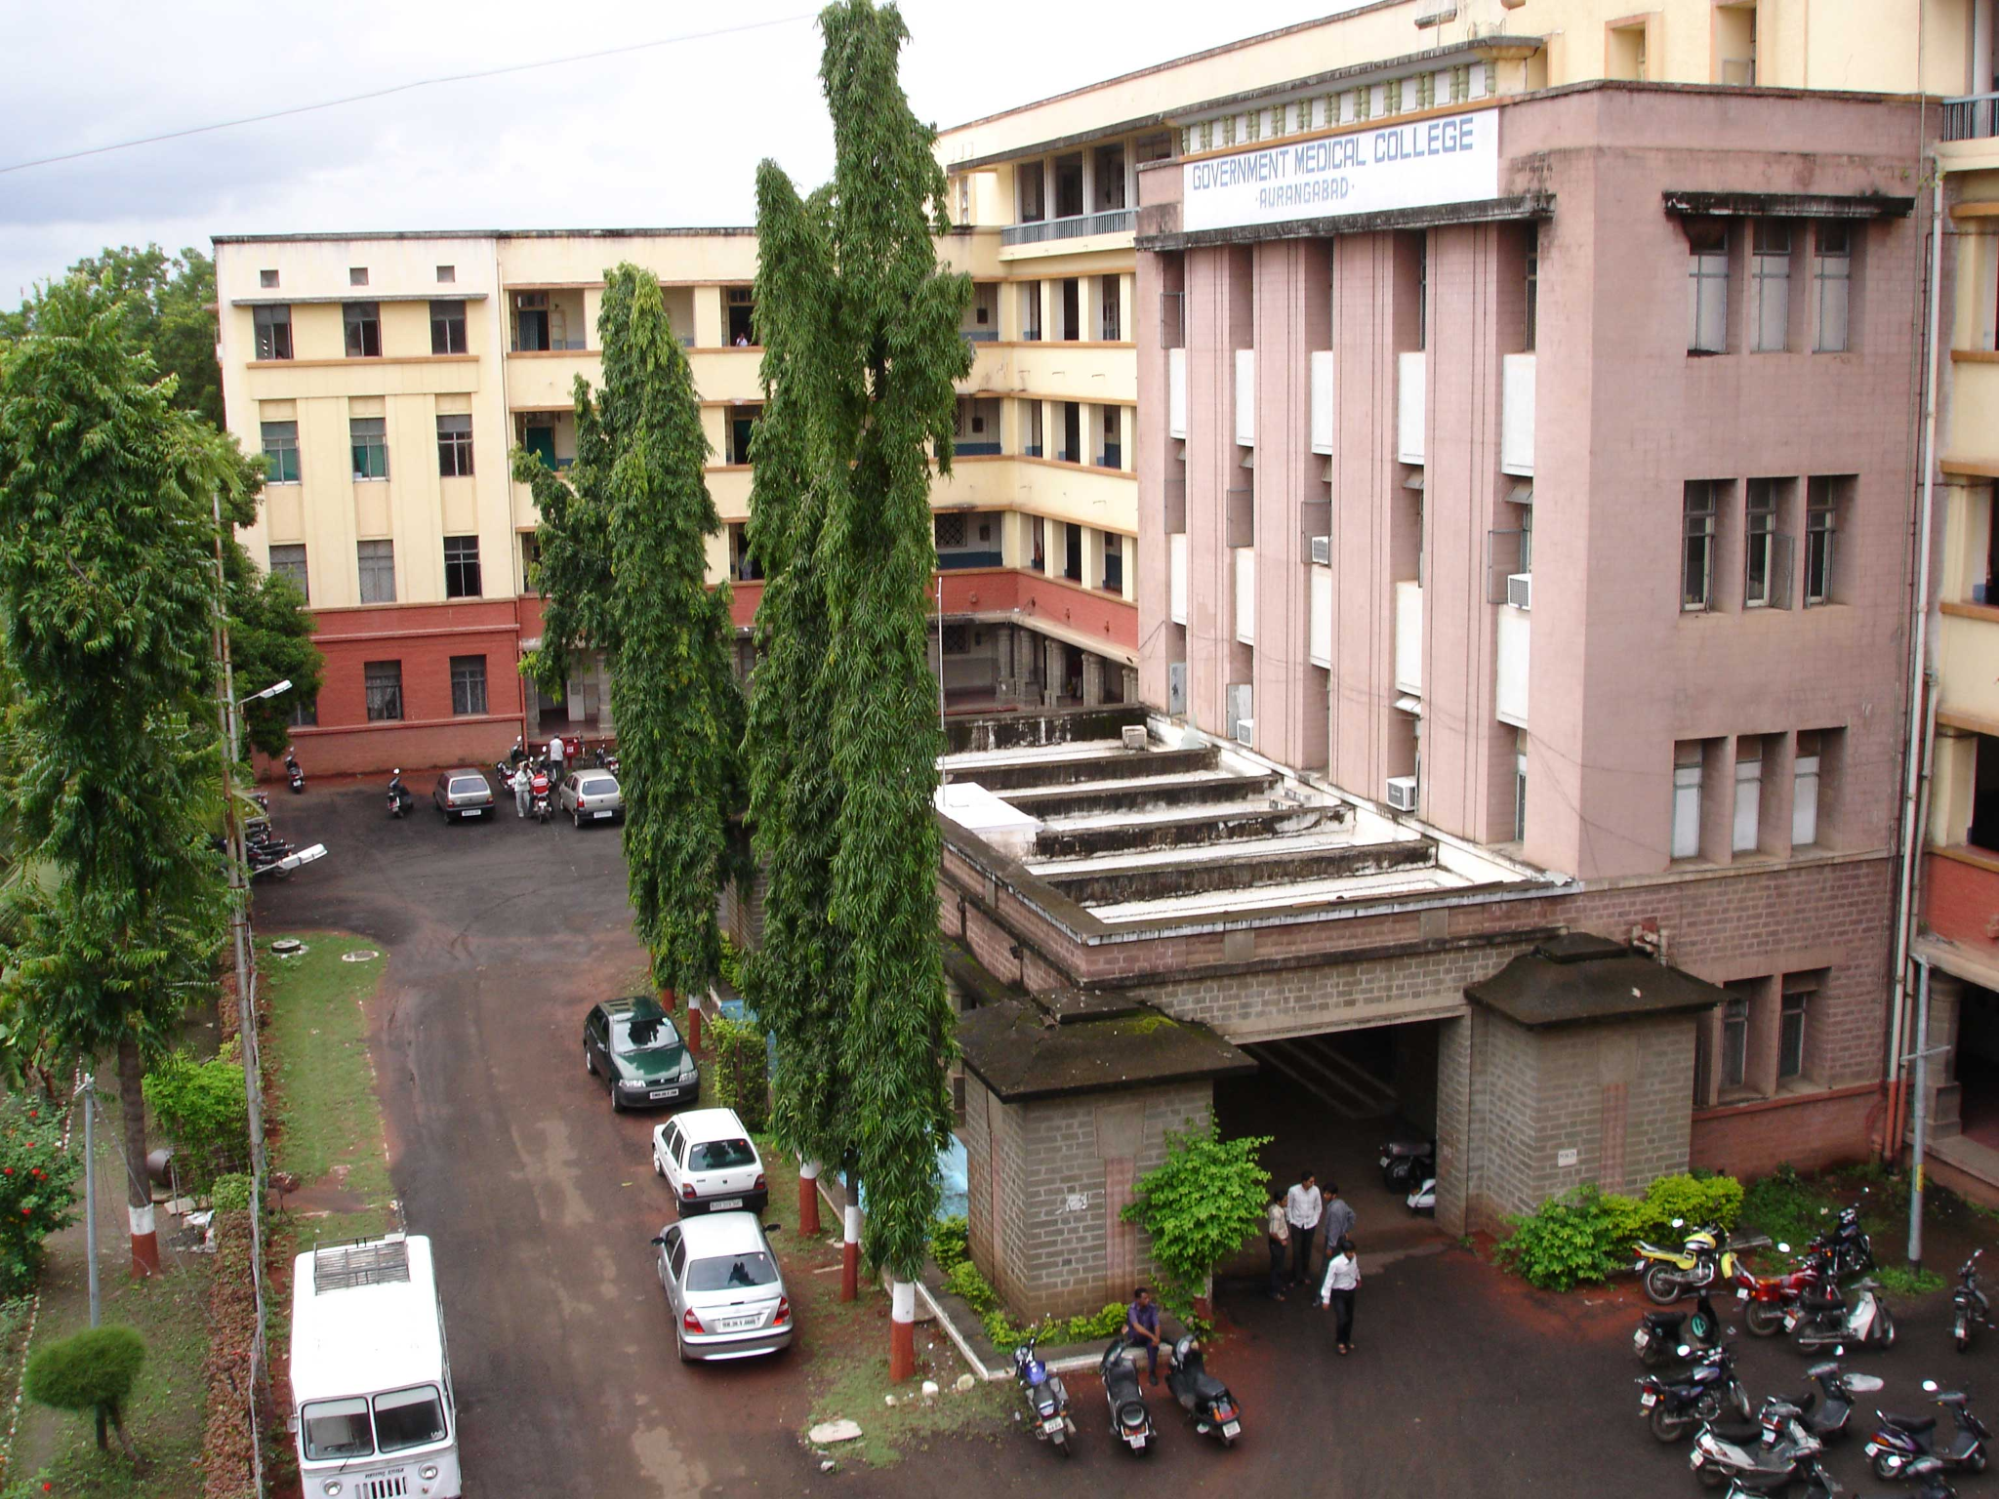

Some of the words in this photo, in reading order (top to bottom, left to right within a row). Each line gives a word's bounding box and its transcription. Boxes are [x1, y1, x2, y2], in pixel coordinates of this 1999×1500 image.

[1192, 149, 1290, 191] GOVERNMENT
[1294, 137, 1367, 176] MEDICAL
[1374, 116, 1475, 164] COLLEGE
[1259, 177, 1350, 210] AURANGABAD
